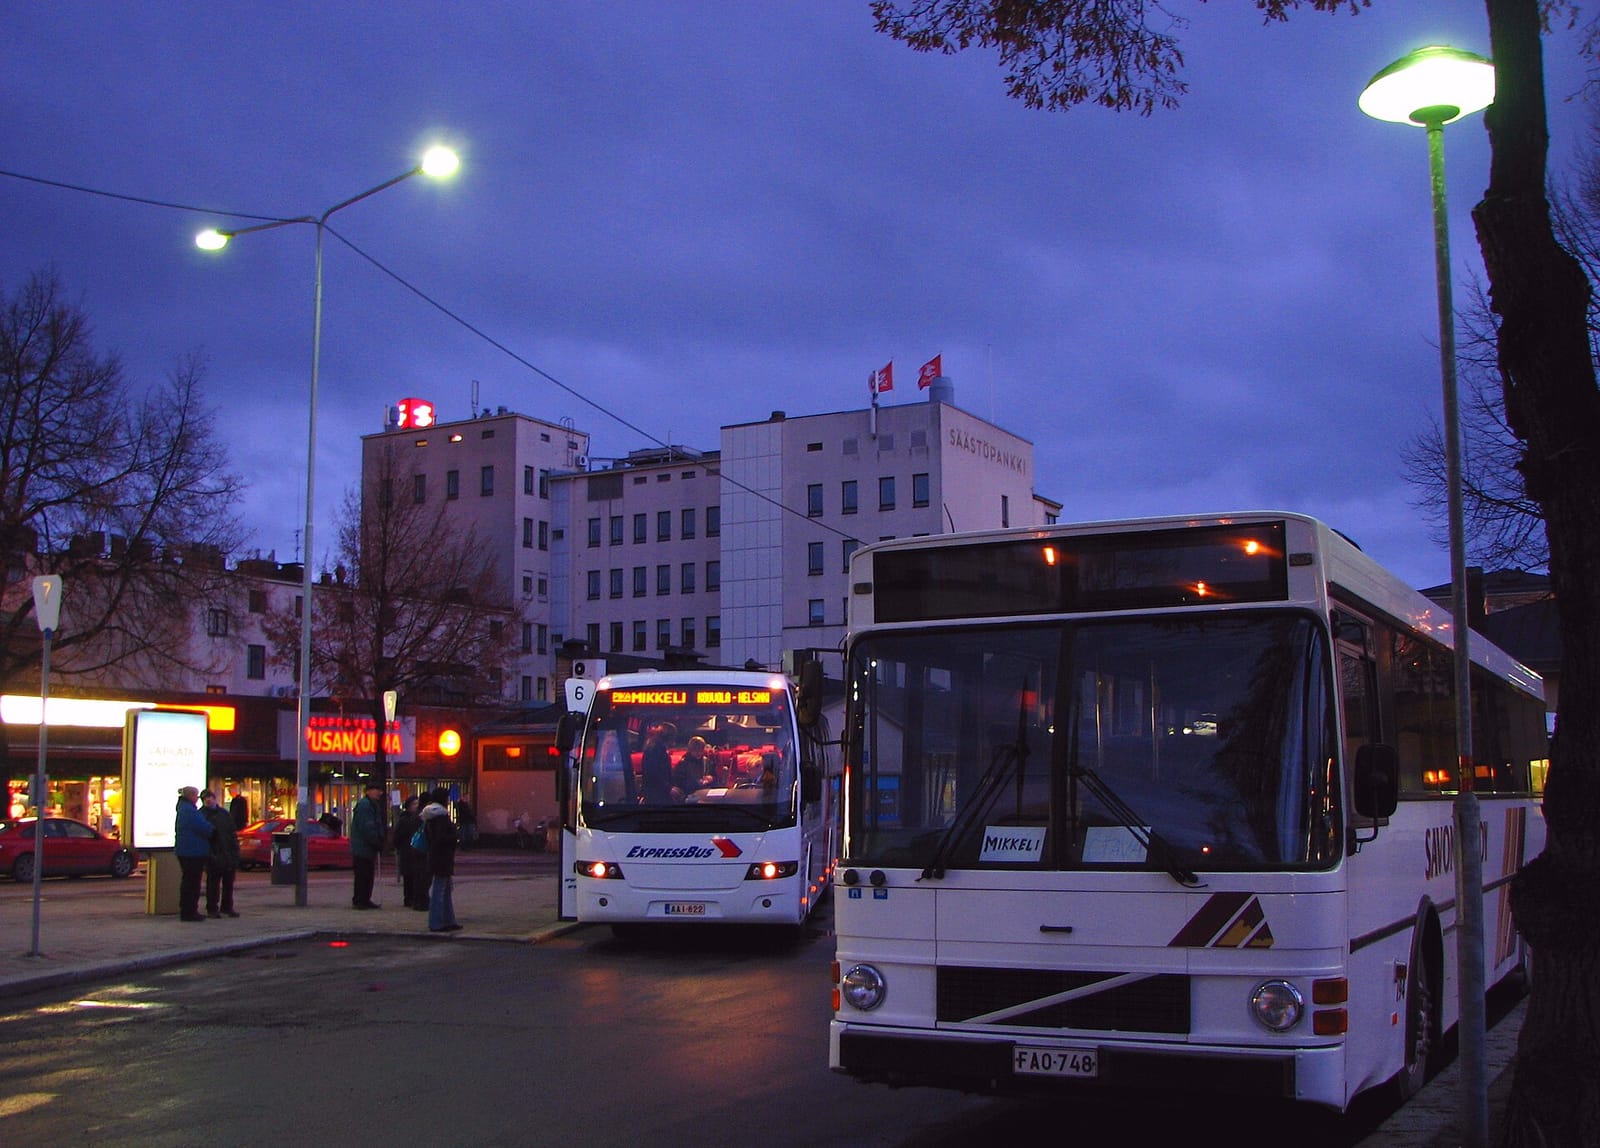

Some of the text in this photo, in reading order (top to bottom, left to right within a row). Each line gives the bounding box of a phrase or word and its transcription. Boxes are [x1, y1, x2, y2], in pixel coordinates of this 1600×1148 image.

[949, 428, 1027, 475] SÄÄSTÖPANKKI
[40, 580, 52, 604] 7
[575, 686, 584, 701] 6
[631, 692, 686, 703] MIKKELI
[983, 834, 1039, 852] MIKKELI
